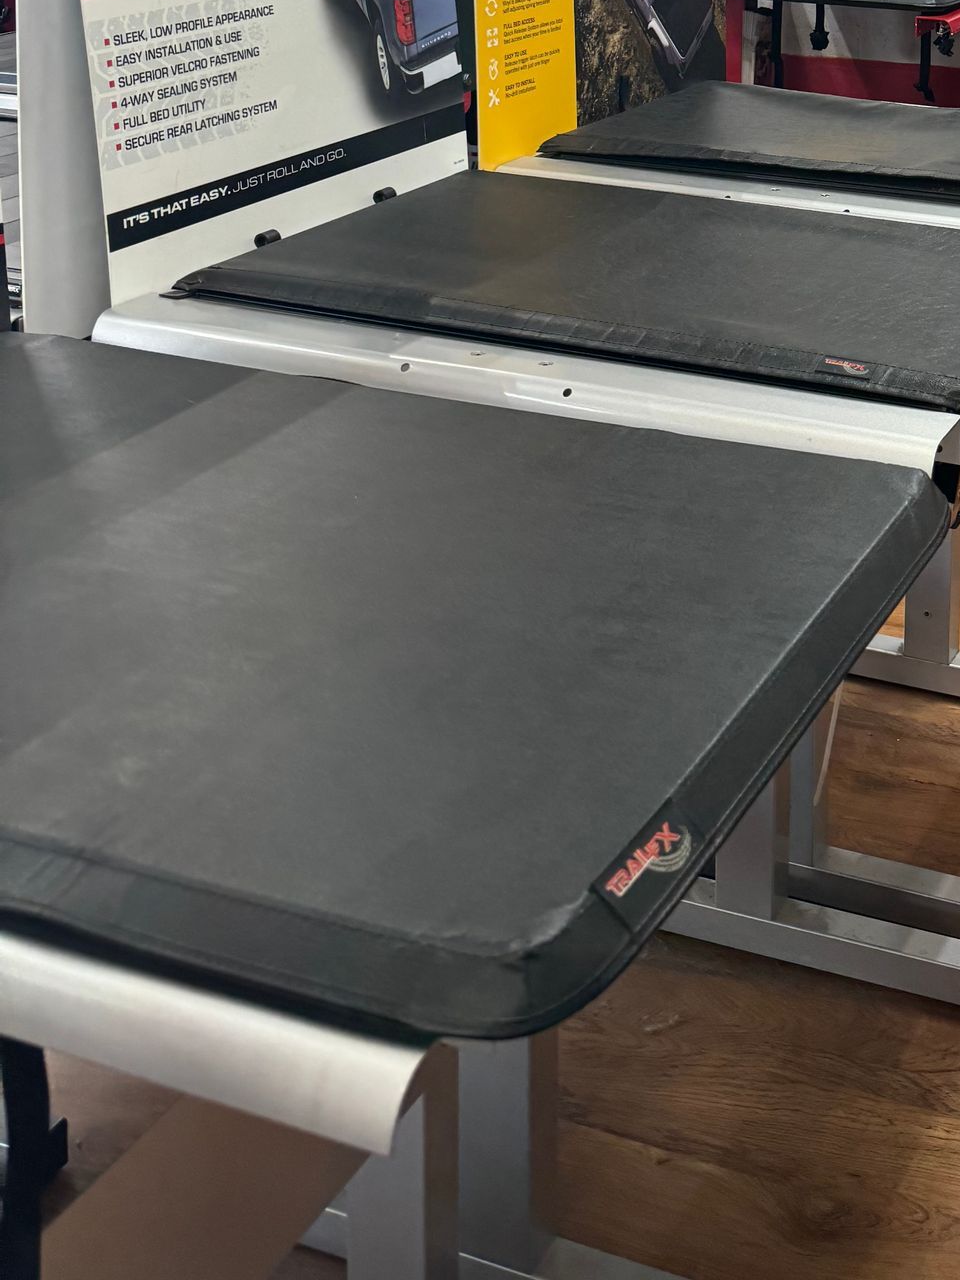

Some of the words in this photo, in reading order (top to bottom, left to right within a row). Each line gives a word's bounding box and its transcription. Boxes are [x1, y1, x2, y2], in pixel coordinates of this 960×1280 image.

[113, 29, 148, 47] SLEEK,
[150, 24, 173, 39] LOW
[175, 16, 214, 34] PROFILE
[215, 4, 275, 26] APPEARANCE
[116, 51, 142, 68] EASY
[145, 36, 213, 61] INSTALLATION
[215, 34, 223, 46] &
[224, 30, 242, 44] USE
[118, 66, 169, 88] SUPERIOR
[171, 58, 208, 76] VELCRO
[209, 46, 260, 67] FASTENING
[120, 90, 155, 109] 4-WAY
[157, 80, 198, 100] SEALING
[200, 71, 238, 90] SYSTEM
[123, 114, 148, 130] FULL
[150, 108, 170, 123] BED
[172, 98, 206, 116] UTILITY
[125, 130, 165, 151] SECURE
[167, 122, 193, 139] REAR
[195, 110, 241, 131] LATCHING
[242, 99, 278, 118] SYSTEM
[123, 211, 150, 229] IT'S
[150, 199, 188, 221] THAT
[190, 185, 231, 207] EASY.
[231, 173, 266, 193] JUST
[266, 163, 298, 182] ROLL
[299, 154, 324, 171] AND
[326, 147, 347, 163] GO.
[605, 821, 681, 897] TRAILFX
